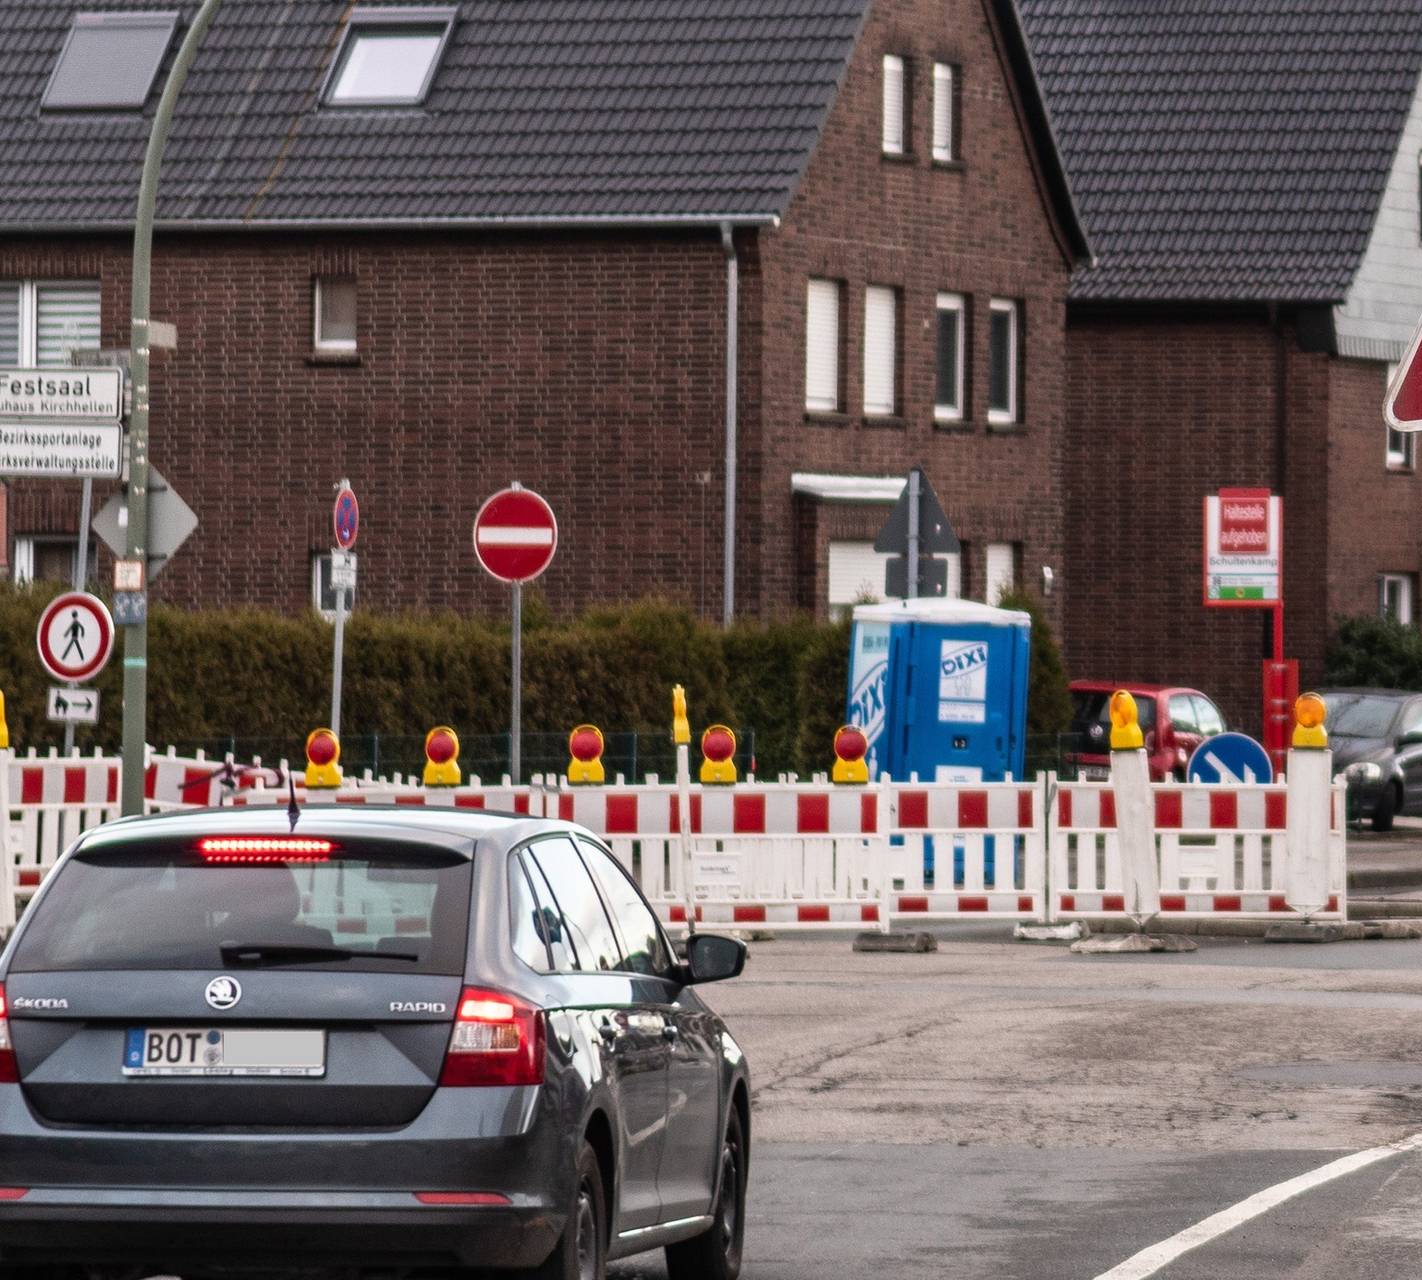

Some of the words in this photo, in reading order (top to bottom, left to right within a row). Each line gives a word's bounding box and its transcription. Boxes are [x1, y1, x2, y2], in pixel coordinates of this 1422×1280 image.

[942, 646, 986, 676] DIXI
[390, 1001, 446, 1014] RAPID
[147, 1033, 202, 1063] BOT
